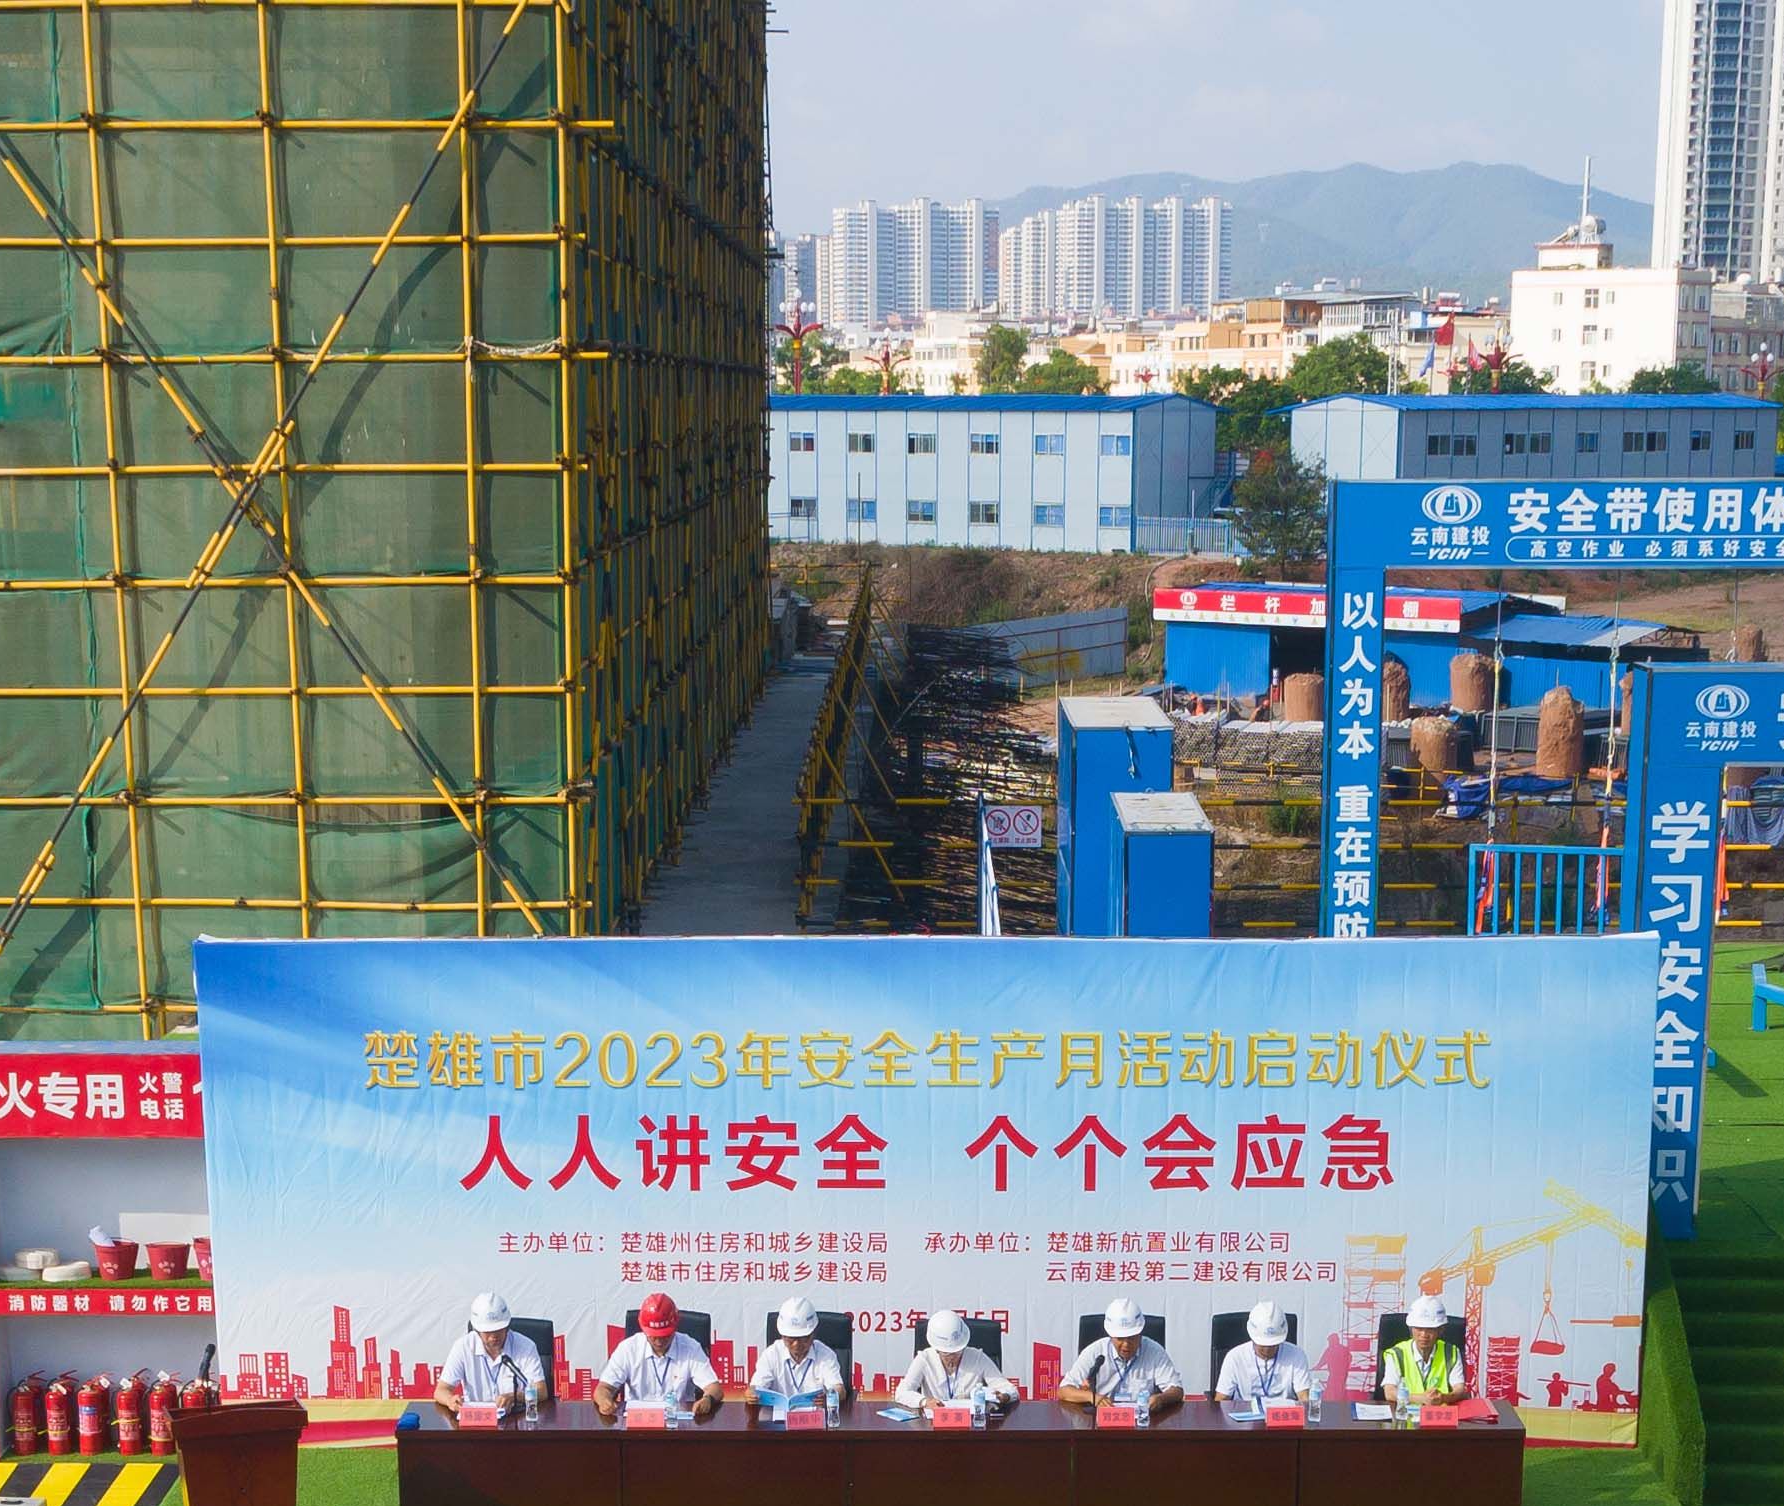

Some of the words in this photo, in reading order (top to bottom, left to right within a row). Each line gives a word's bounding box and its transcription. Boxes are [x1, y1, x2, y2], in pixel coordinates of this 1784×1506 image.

[1411, 526, 1489, 545] 云南建投
[1428, 547, 1471, 560] YCIH
[1530, 540, 1625, 558] 高空作业
[1339, 591, 1377, 759] 以人为本
[1686, 721, 1757, 739] 云南建投
[1700, 740, 1740, 751] YCIH
[1333, 787, 1373, 938] 重在预防
[364, 1029, 1493, 1091] 楚雄市2023年安全生产月活动启动仪式
[139, 1071, 183, 1094] 火警
[139, 1097, 185, 1121] 电话
[459, 1114, 889, 1192] 人人讲安全
[964, 1113, 1395, 1192] 个个会应急
[620, 1260, 888, 1284] 楚雄市住房和城乡建设局
[1046, 1260, 1338, 1284] 云南建投第二建设有限公司
[9, 1294, 90, 1312] 消防器材
[109, 1294, 213, 1312] 请勿作它用
